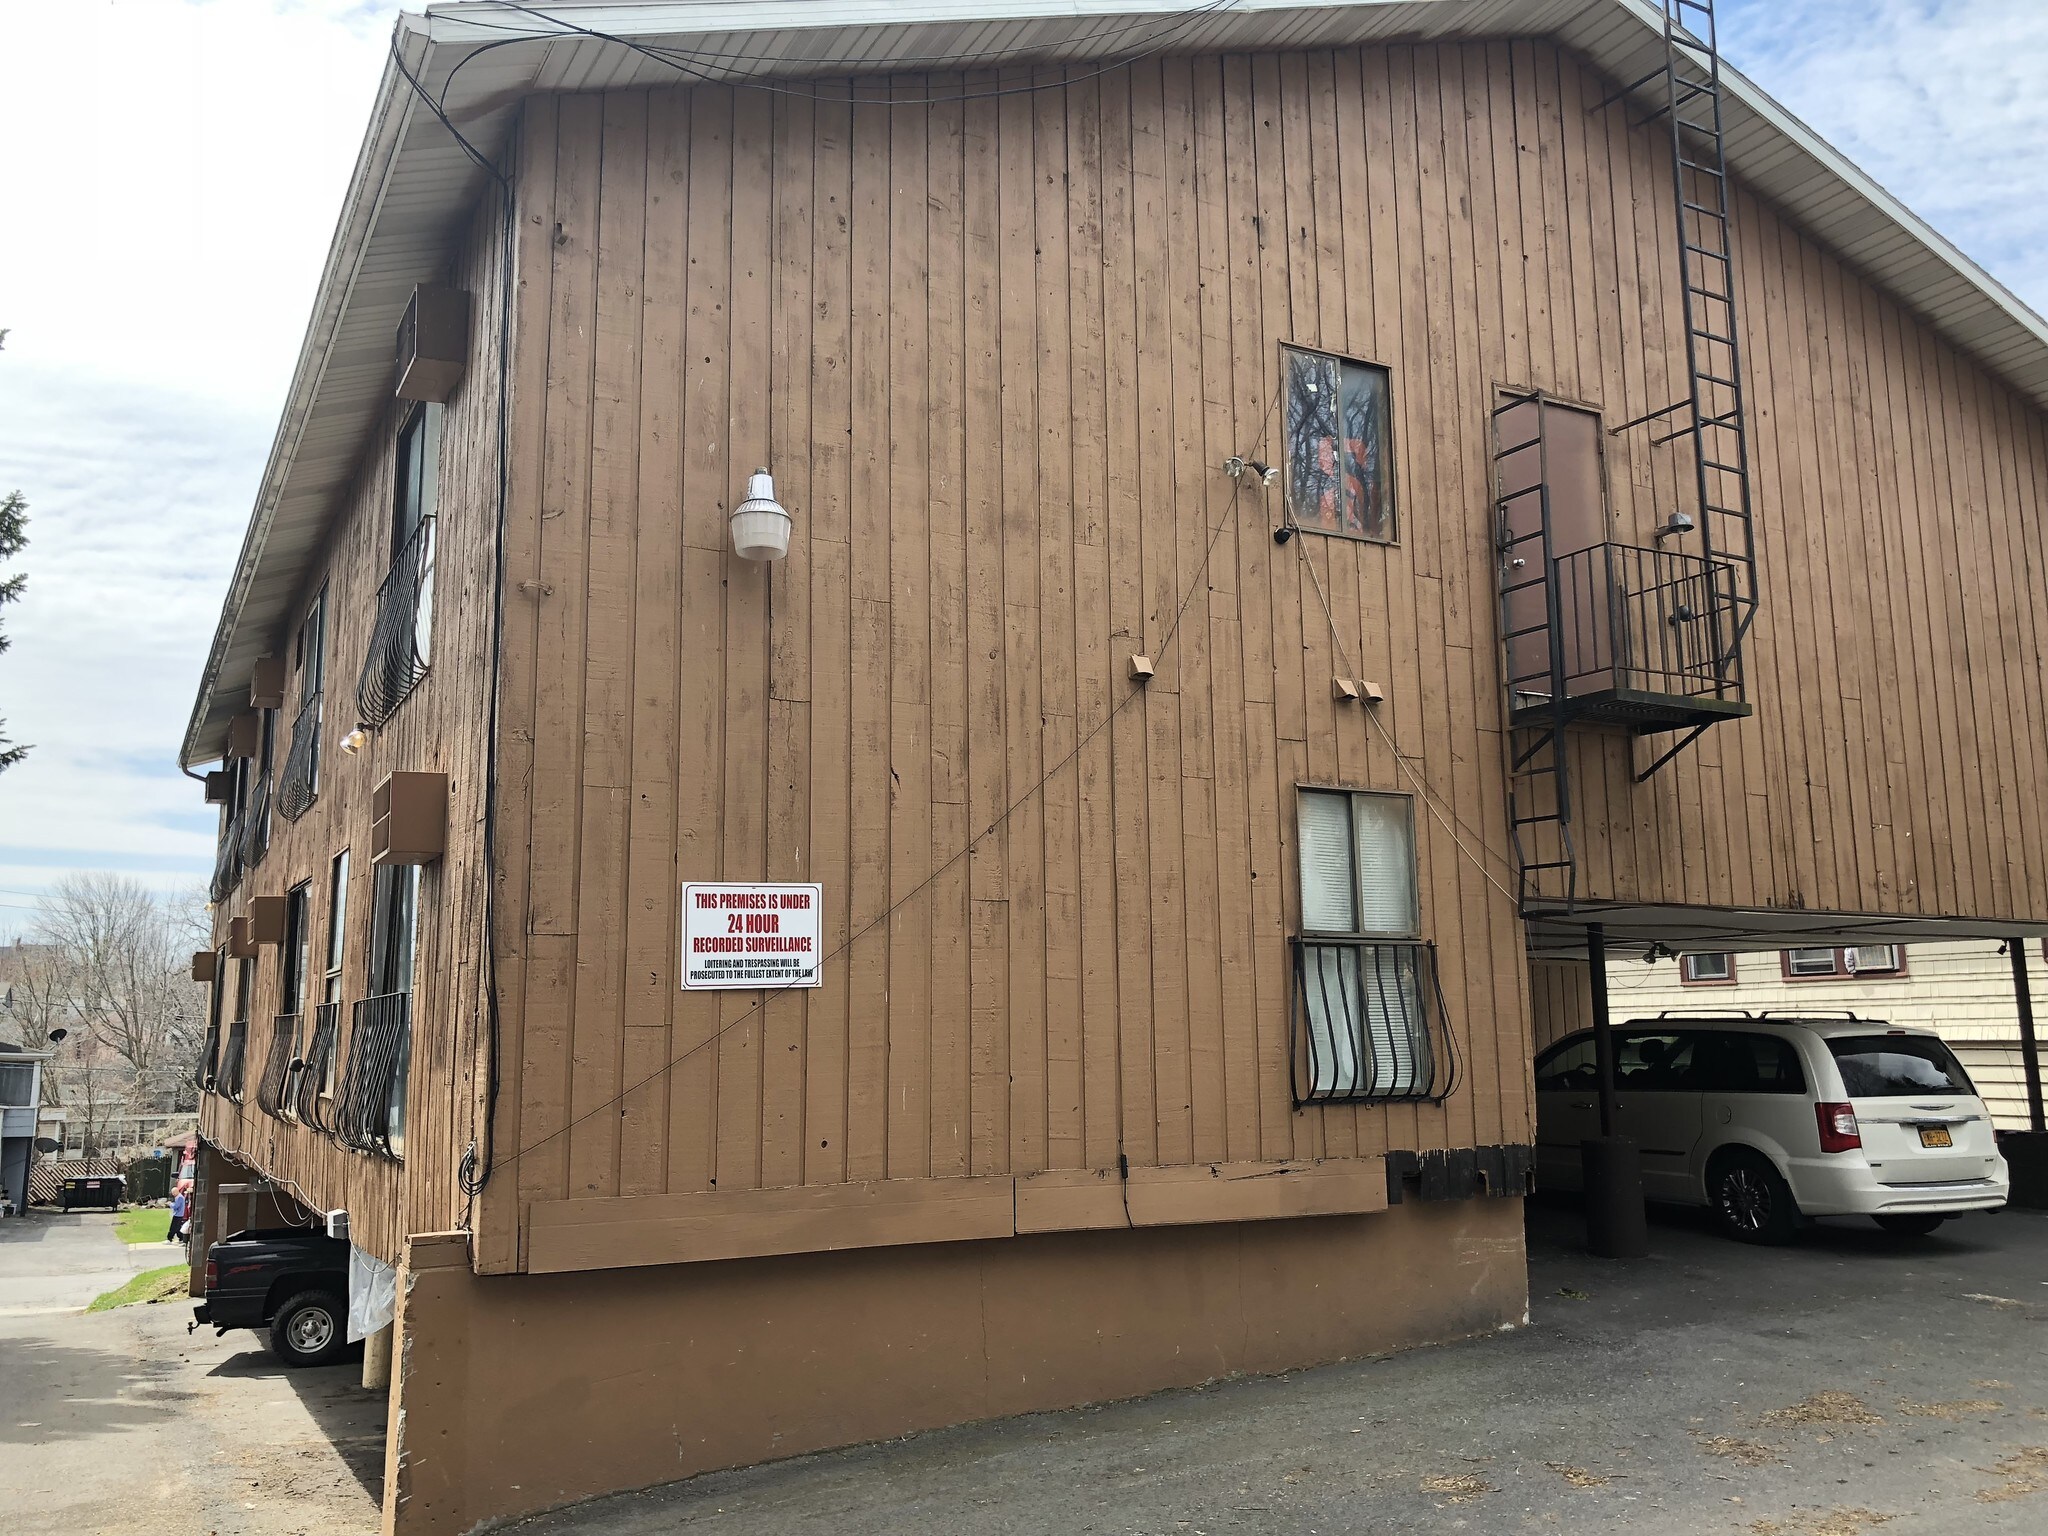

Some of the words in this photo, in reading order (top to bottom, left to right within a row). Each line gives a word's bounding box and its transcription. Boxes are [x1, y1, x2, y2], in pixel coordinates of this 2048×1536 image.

[695, 893, 718, 909] THIS
[720, 893, 767, 909] PREMISES
[768, 894, 778, 909] IS
[780, 894, 811, 909] UNDER
[728, 914, 743, 933] 24
[746, 914, 779, 934] HOUR
[693, 937, 743, 953] RECORDED
[745, 937, 812, 952] SURVEILLANCE
[704, 959, 732, 969] LOITERING
[733, 959, 744, 968] AND
[744, 959, 780, 968] TRESPASSING
[780, 958, 792, 968] WILL
[793, 958, 800, 967] BE
[690, 970, 725, 980] PROSECUTED
[725, 970, 733, 979] TO
[734, 970, 744, 979] THE
[744, 970, 765, 979] FULLEST
[765, 969, 784, 978] EXTENT
[784, 969, 791, 978] OF
[792, 969, 801, 978] THE
[802, 969, 814, 978] LAW
